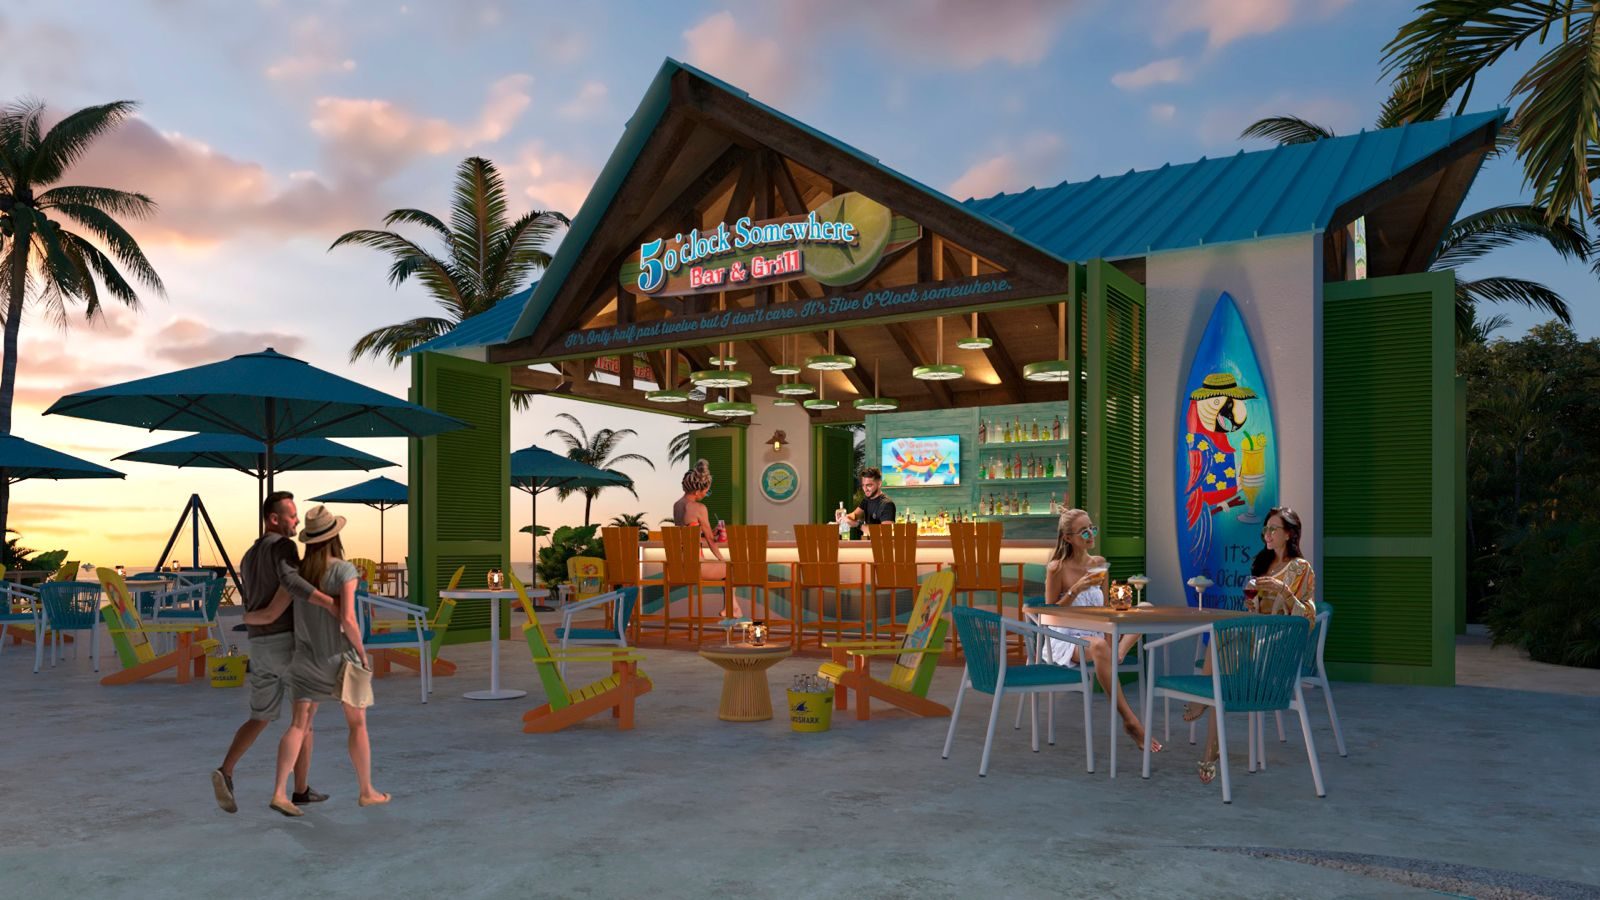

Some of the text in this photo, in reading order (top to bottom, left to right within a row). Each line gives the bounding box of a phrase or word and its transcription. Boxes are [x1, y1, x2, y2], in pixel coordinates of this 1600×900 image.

[638, 211, 854, 291] 5 o'clock Somewhere
[690, 249, 800, 288] Bar & Grill
[564, 332, 584, 348] It's
[586, 330, 611, 345] Only
[612, 324, 636, 343] half
[635, 322, 660, 340] past
[661, 319, 698, 333] twelve
[699, 316, 720, 329] but
[720, 311, 732, 328] I
[732, 308, 765, 325] don't
[765, 307, 798, 321] care.
[801, 299, 826, 317] It's
[829, 296, 860, 314] Five
[921, 279, 1013, 301] somewhere.
